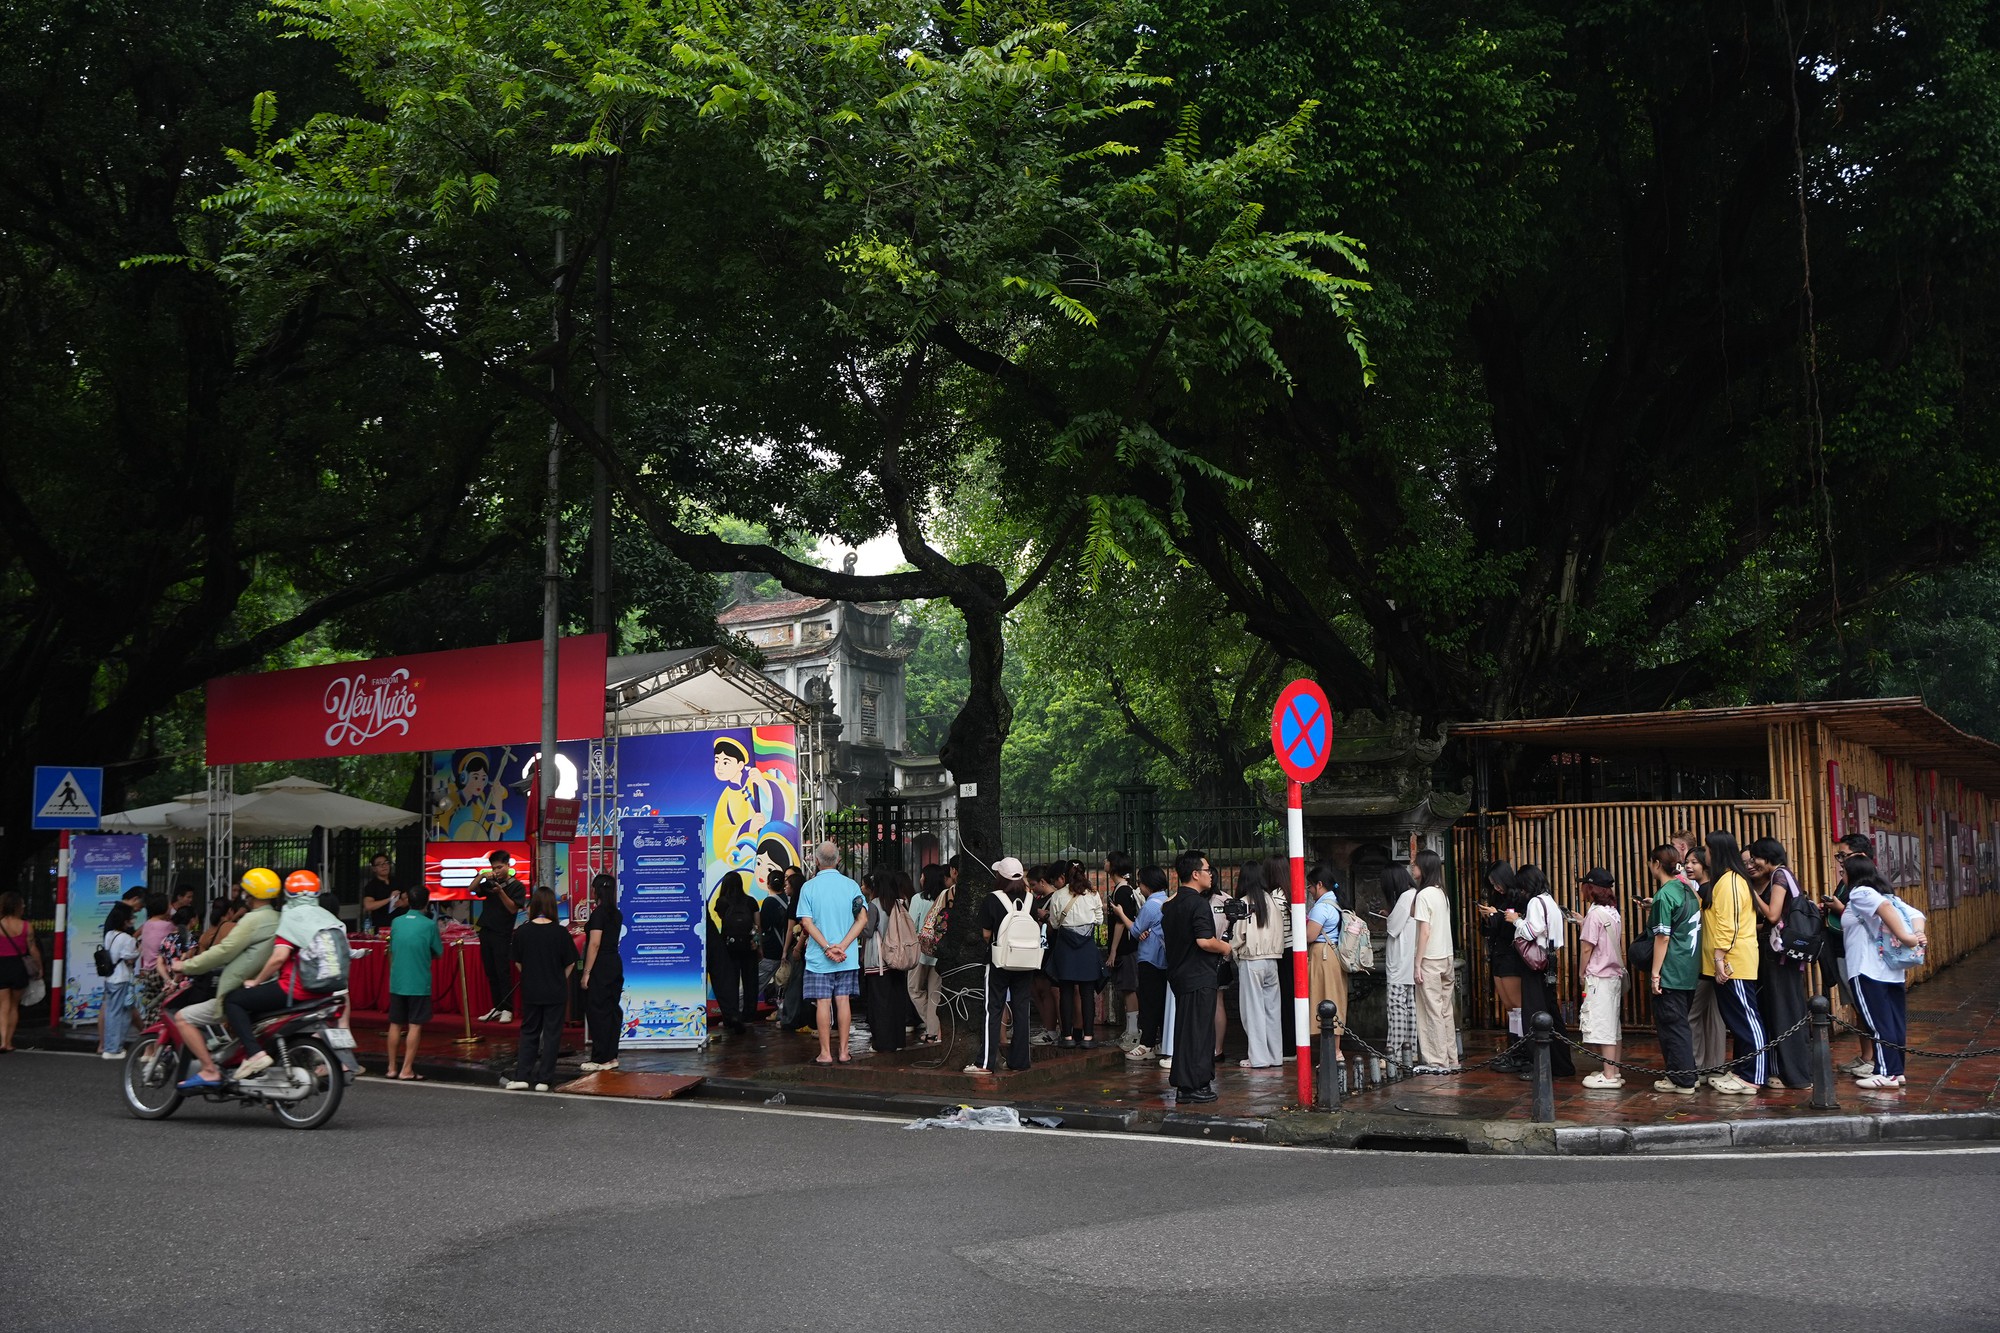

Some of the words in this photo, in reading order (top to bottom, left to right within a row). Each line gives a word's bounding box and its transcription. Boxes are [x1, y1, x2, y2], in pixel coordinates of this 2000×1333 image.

[371, 676, 399, 686] FANDOM
[324, 674, 374, 747] Yêu
[352, 668, 417, 746] Nước
